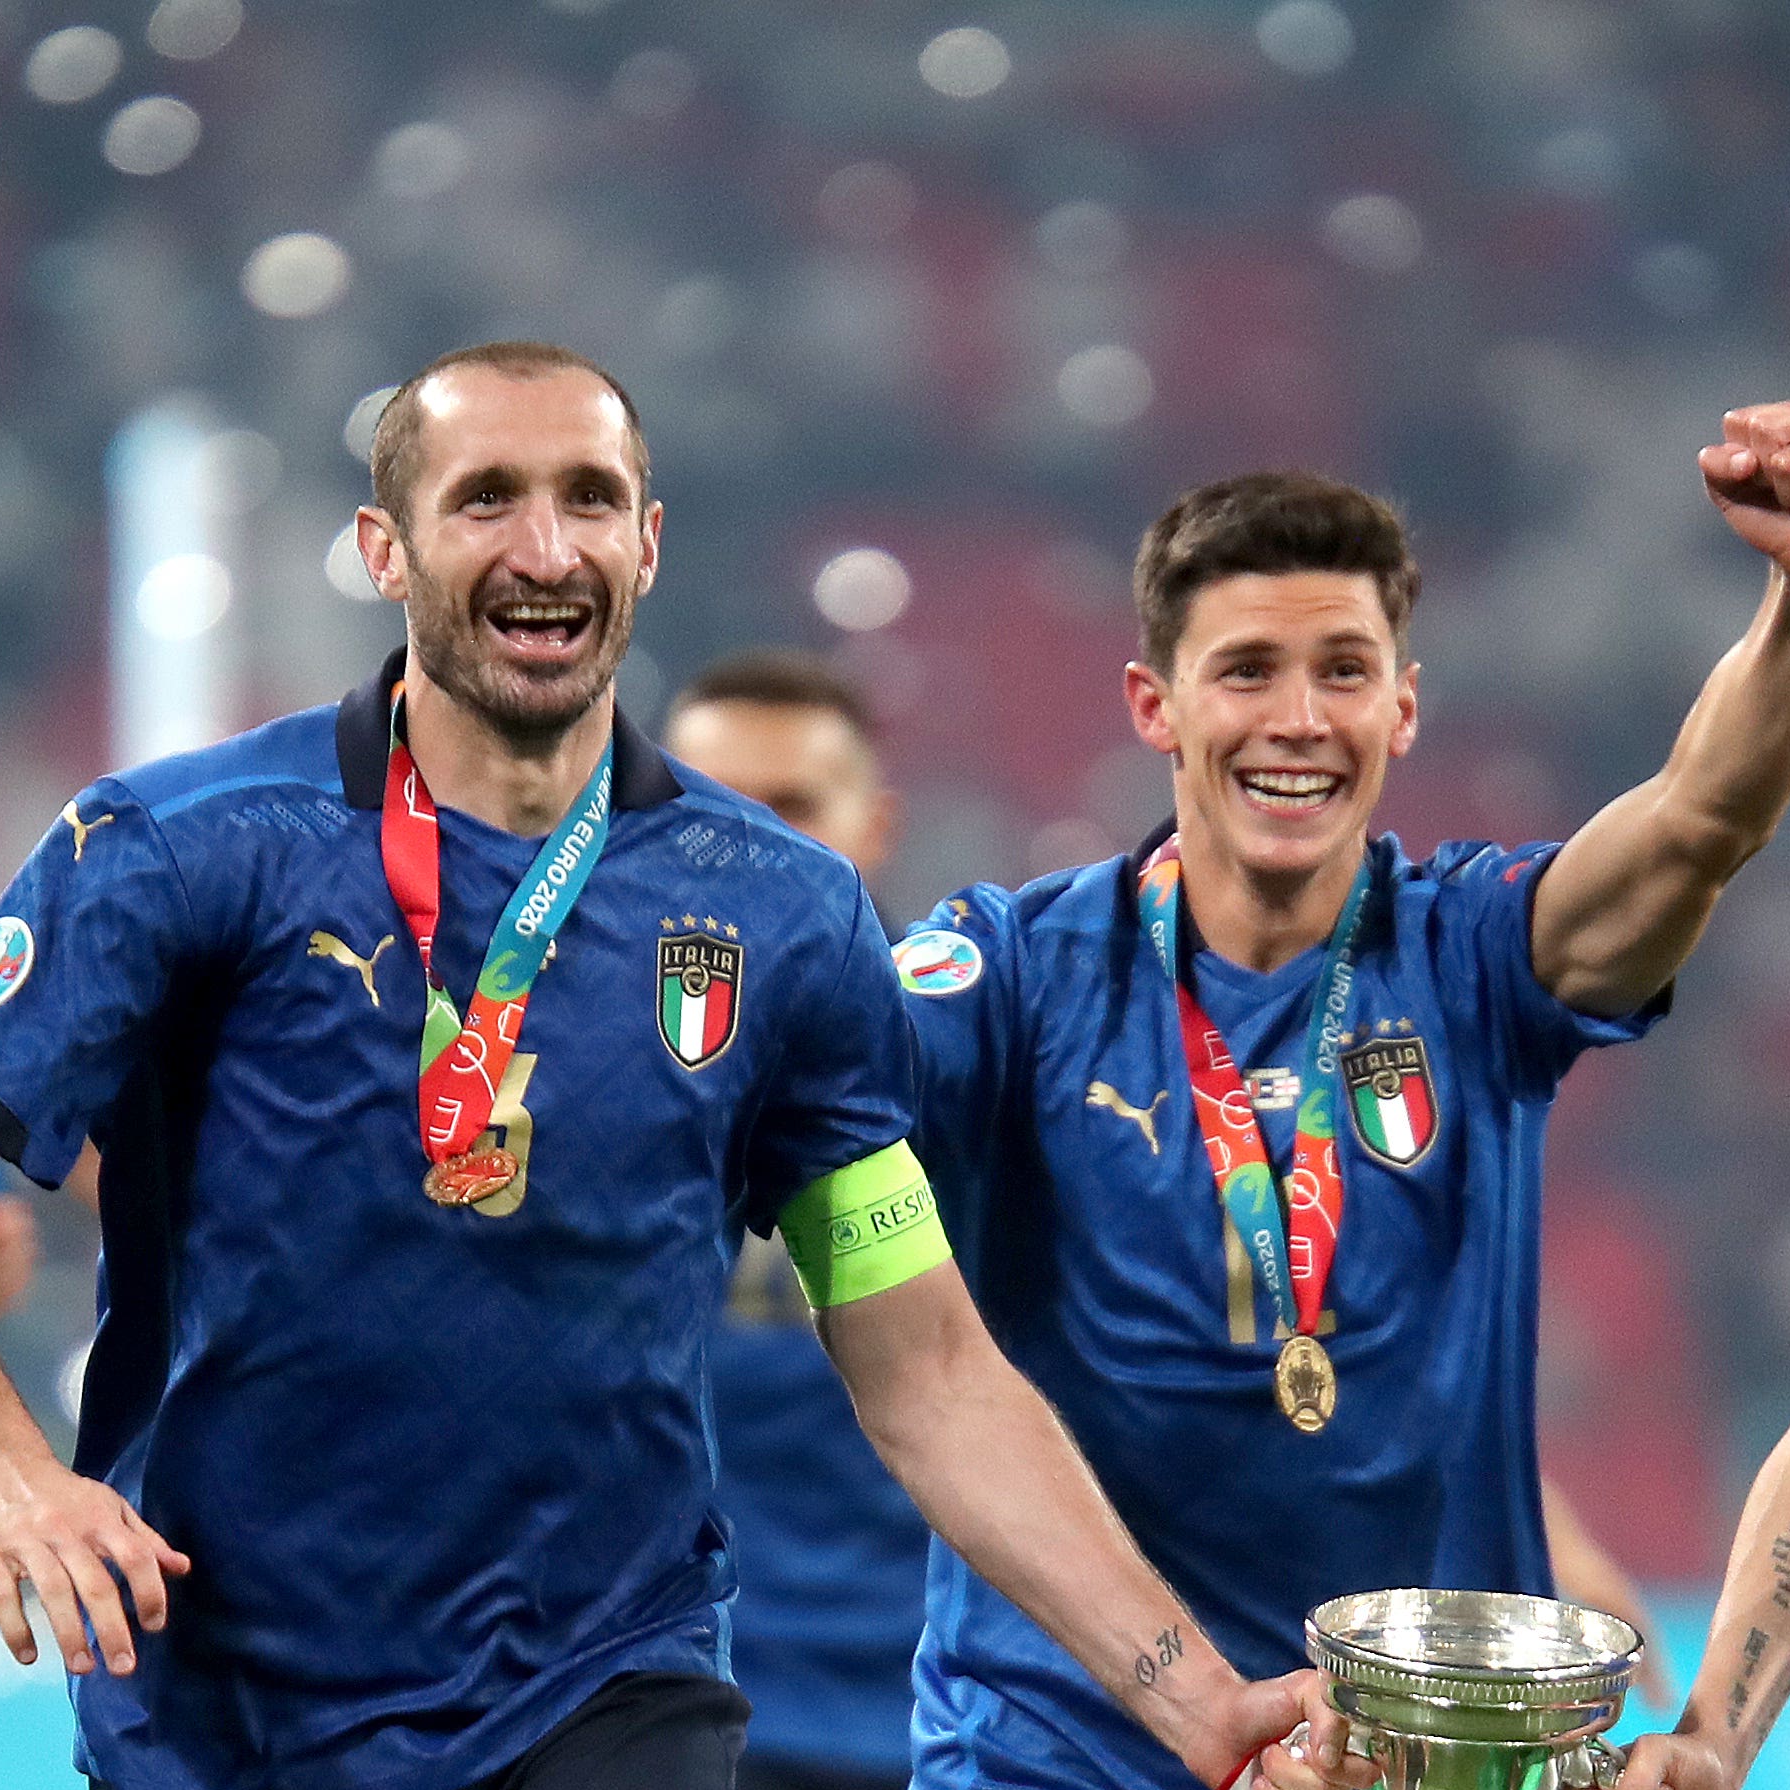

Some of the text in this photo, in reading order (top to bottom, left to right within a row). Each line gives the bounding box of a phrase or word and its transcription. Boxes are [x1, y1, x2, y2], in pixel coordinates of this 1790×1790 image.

[546, 819, 595, 887] EURO
[514, 879, 558, 937] 2020
[664, 945, 733, 971] ITALIA
[1316, 1012, 1342, 1073] 2020
[1348, 1046, 1417, 1076] ITALIA
